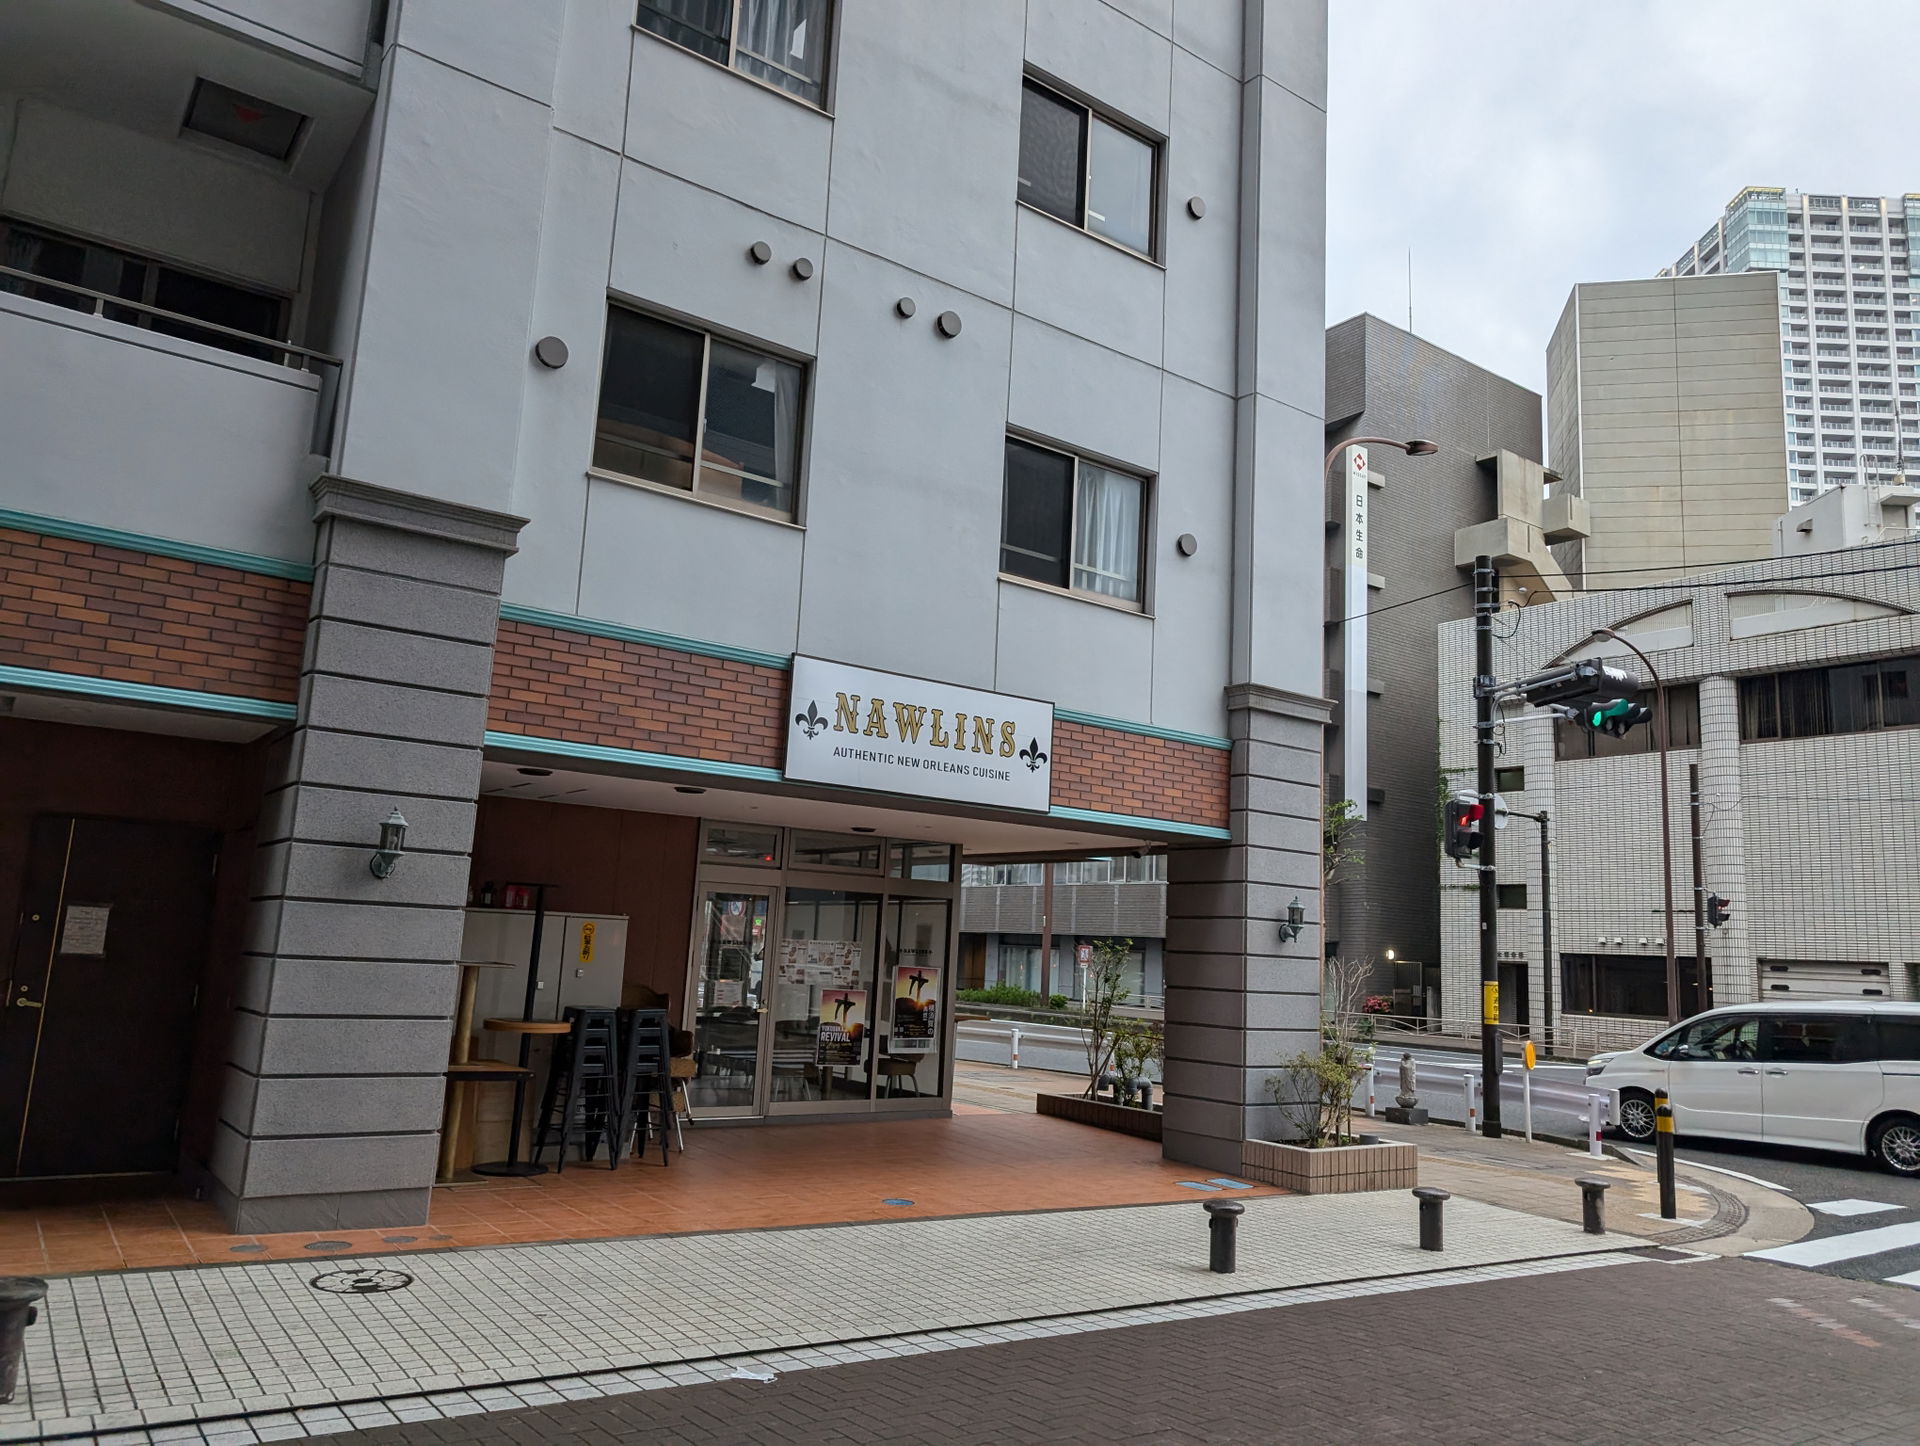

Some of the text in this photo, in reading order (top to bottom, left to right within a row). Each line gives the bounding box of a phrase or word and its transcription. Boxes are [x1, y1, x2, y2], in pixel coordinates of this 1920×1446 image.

[1355, 495, 1363, 559] 日本生命
[833, 692, 1016, 757] NAWLINS
[833, 746, 1011, 782] AUTHENTIC NEW ORLEANS CUISINE
[820, 1032, 851, 1042] REVIVAL
